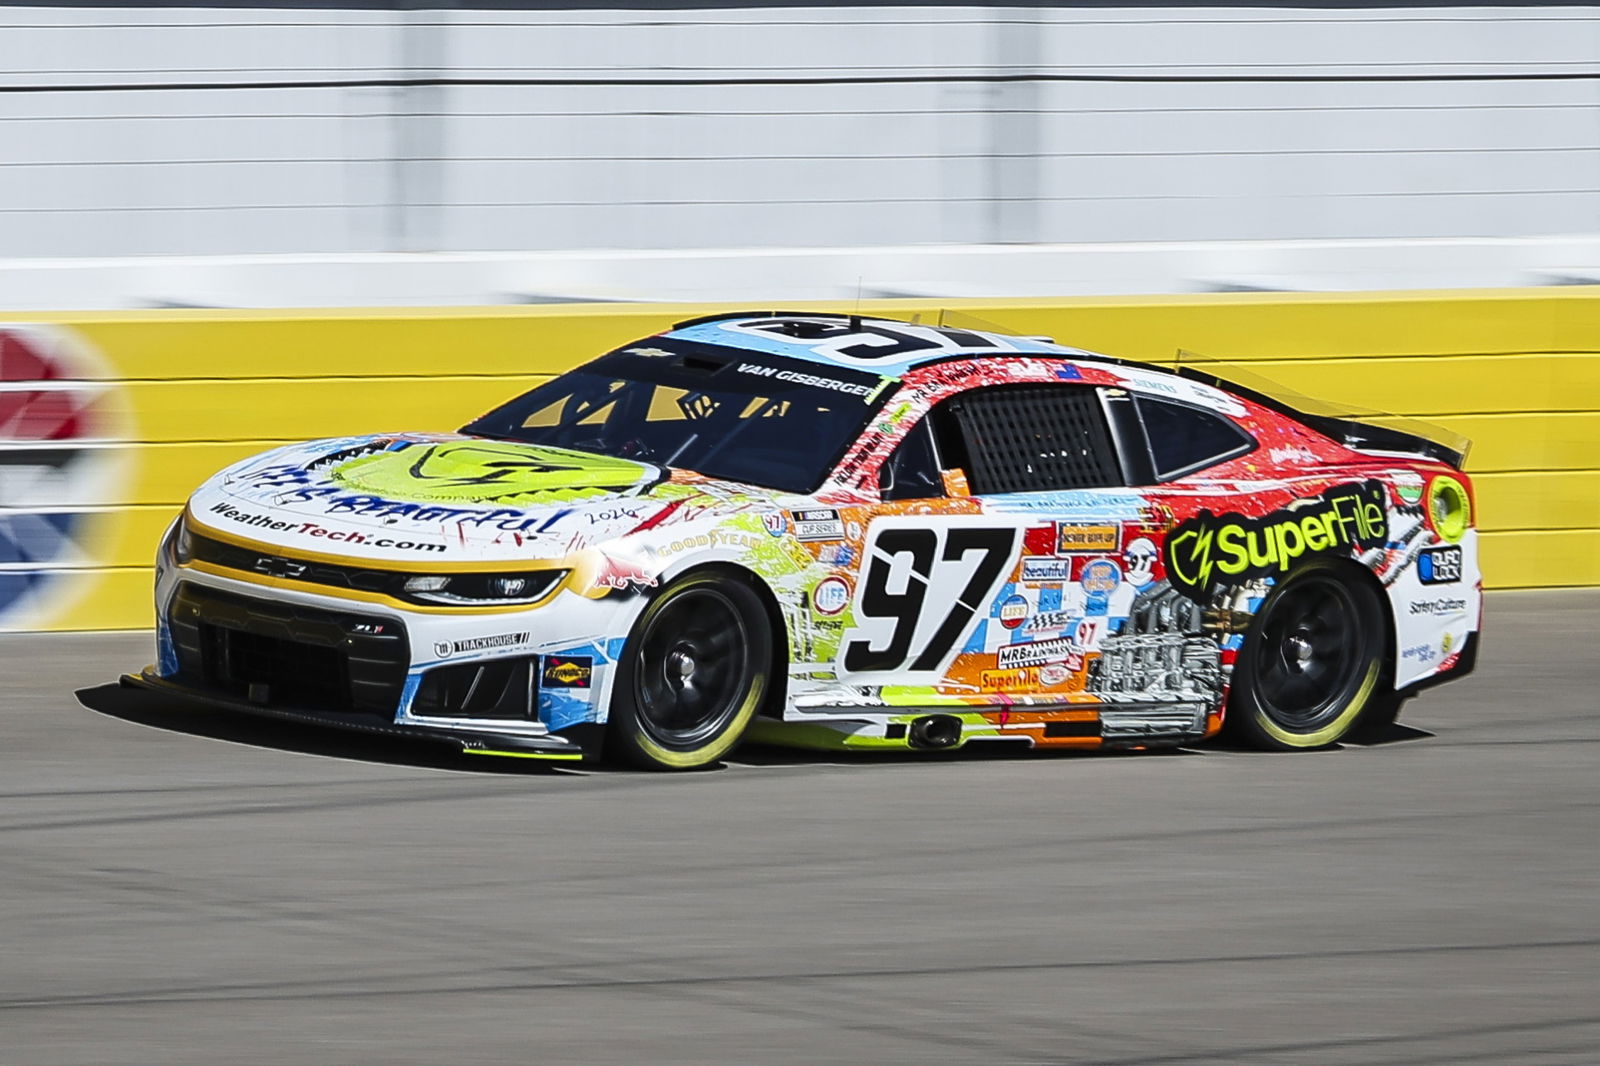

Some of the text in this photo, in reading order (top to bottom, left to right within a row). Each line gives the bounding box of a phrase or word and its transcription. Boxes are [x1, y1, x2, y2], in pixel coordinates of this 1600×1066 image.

[736, 362, 778, 378] VAN
[208, 501, 448, 553] WeatherTech.com
[766, 512, 783, 530] 97
[1216, 494, 1384, 571] SuperFile
[656, 531, 764, 558] GOODYEAR
[1024, 562, 1068, 579] beautiful
[844, 528, 1018, 672] 97
[458, 633, 519, 652] TRACKHOUSE
[1078, 622, 1097, 645] 97
[546, 666, 591, 679] SUNOCO
